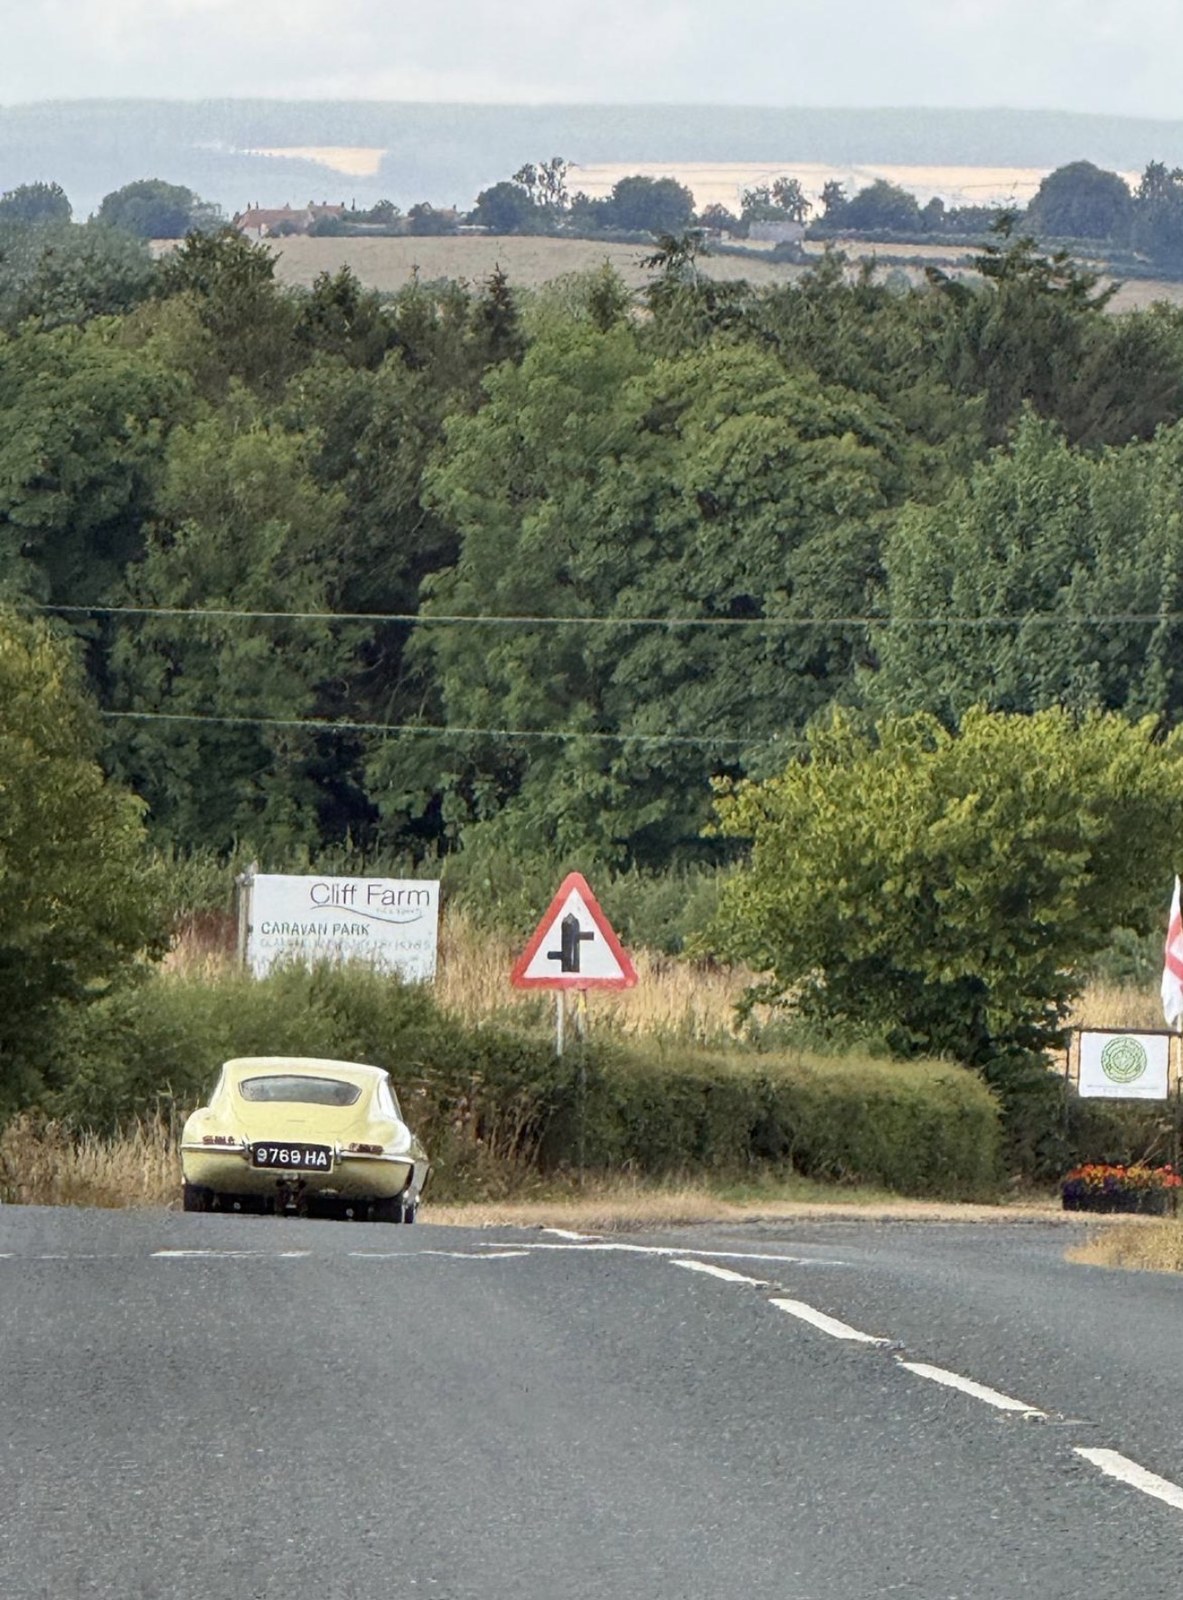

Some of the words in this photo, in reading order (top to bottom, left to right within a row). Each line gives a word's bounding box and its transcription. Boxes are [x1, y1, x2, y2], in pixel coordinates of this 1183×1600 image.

[310, 883, 357, 905] Cliff
[367, 884, 430, 906] Farm
[261, 921, 328, 936] CARAVAN
[332, 922, 370, 936] PARK
[304, 1150, 328, 1166] HA
